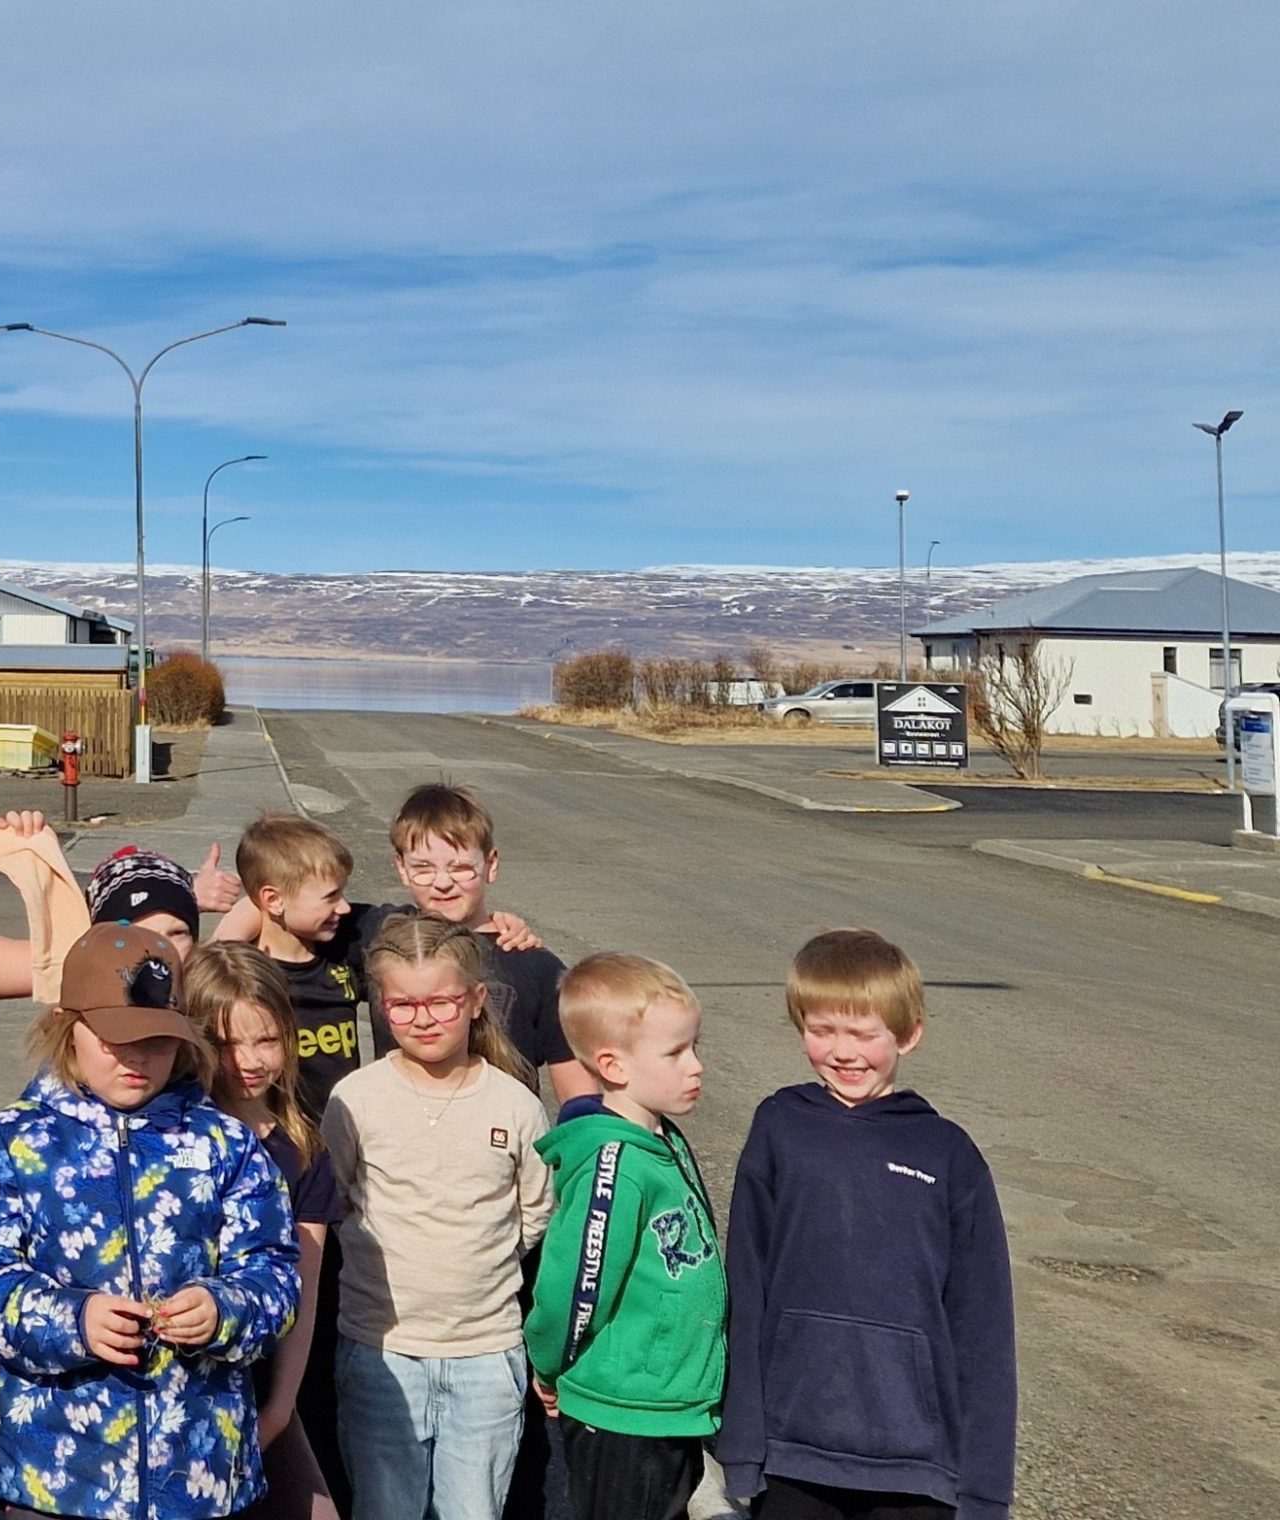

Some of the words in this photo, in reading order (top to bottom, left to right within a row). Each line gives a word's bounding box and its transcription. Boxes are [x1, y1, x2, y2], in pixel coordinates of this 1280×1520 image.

[893, 719, 952, 730] DALAKOT
[297, 1020, 357, 1058] eep
[581, 1208, 607, 1292] FREESTYLE
